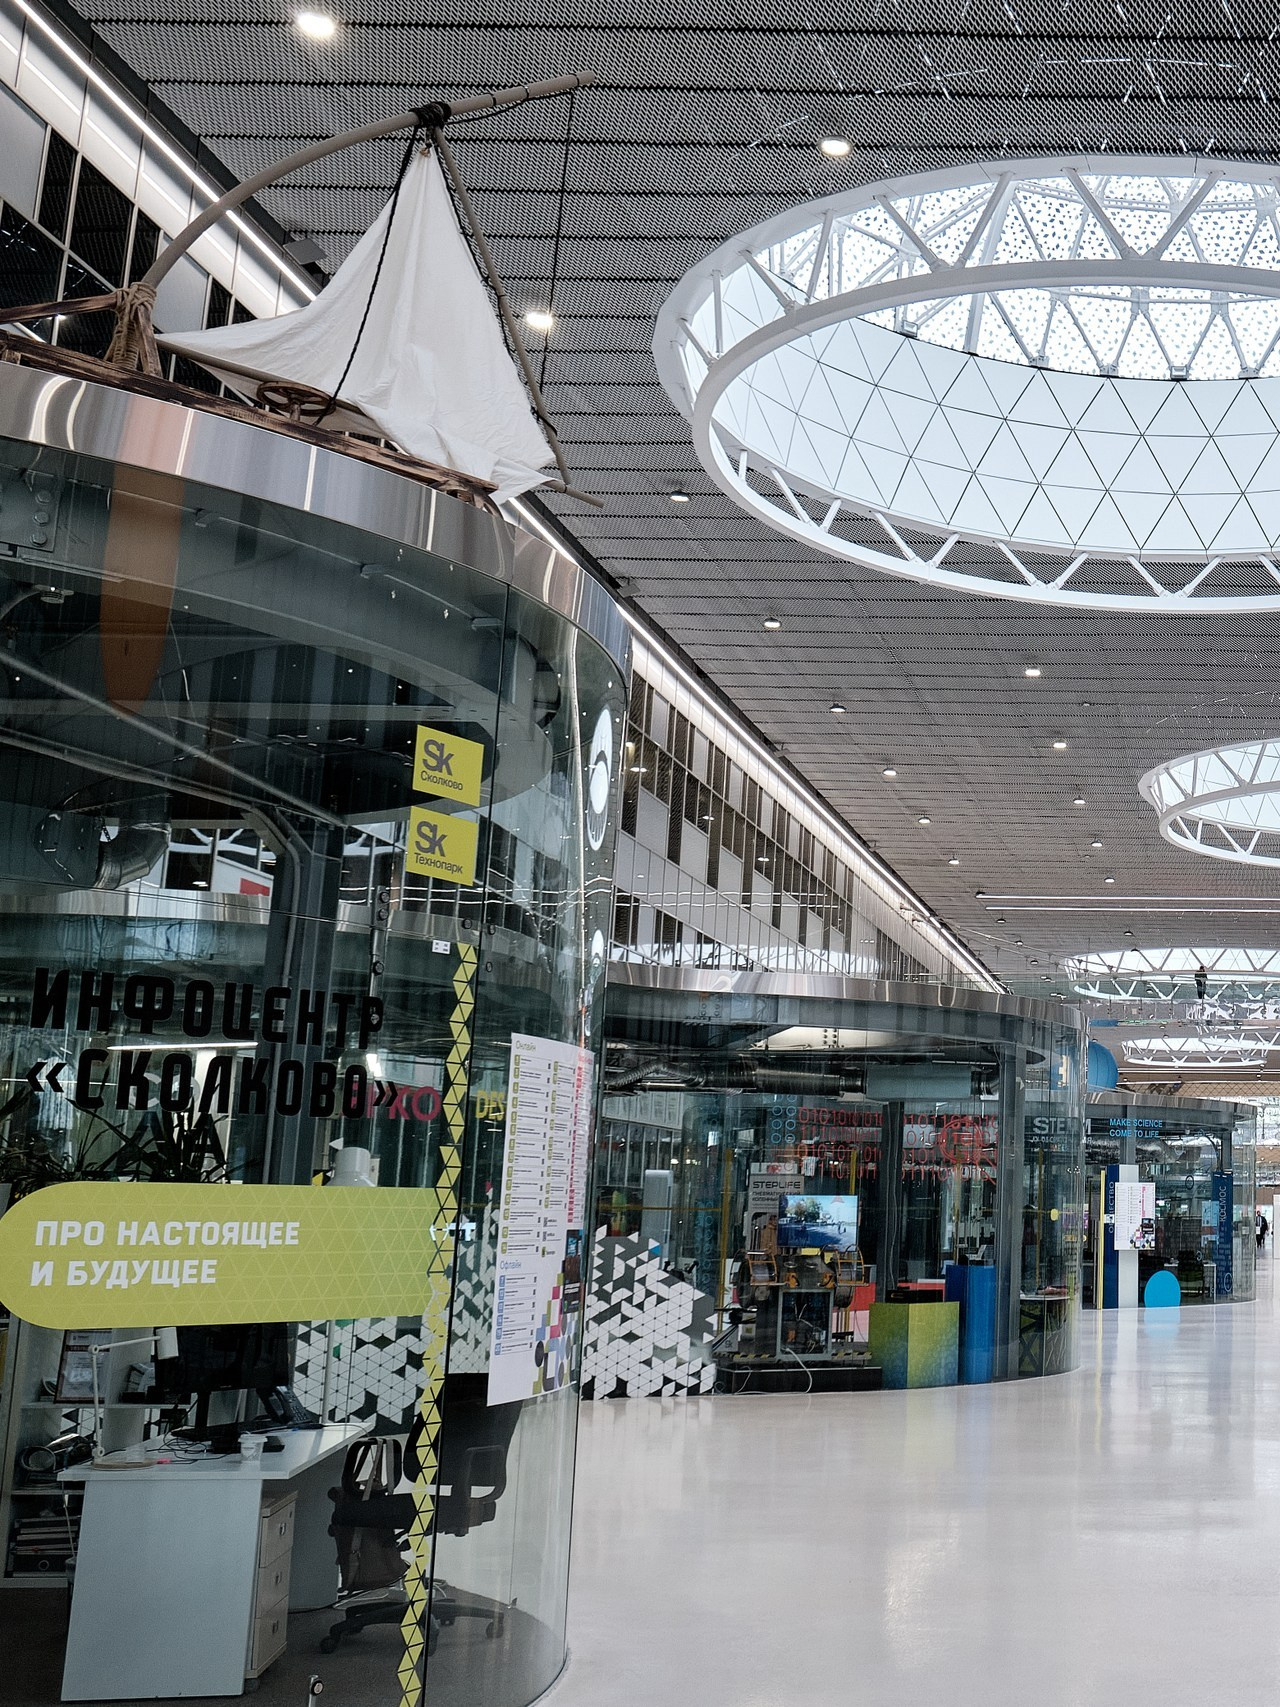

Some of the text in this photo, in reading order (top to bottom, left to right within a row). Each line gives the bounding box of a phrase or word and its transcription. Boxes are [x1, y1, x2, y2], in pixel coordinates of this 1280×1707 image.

[422, 739, 454, 776] Sk
[420, 770, 463, 791] Сколково
[415, 820, 448, 858] Sk
[414, 852, 463, 875] Технопарк
[30, 967, 384, 1050] ИНФОЦЕНТР
[25, 1048, 399, 1120] «СКОЛКОВО»
[1109, 1118, 1163, 1128] MAKE SCIENCE
[1109, 1129, 1159, 1138] COME TO LIFE
[752, 1181, 801, 1189] STEPLIFE
[35, 1220, 300, 1249] ПРО НАСТОЯЩЕЕ
[30, 1259, 218, 1289] И БУДУЩЕЕ
